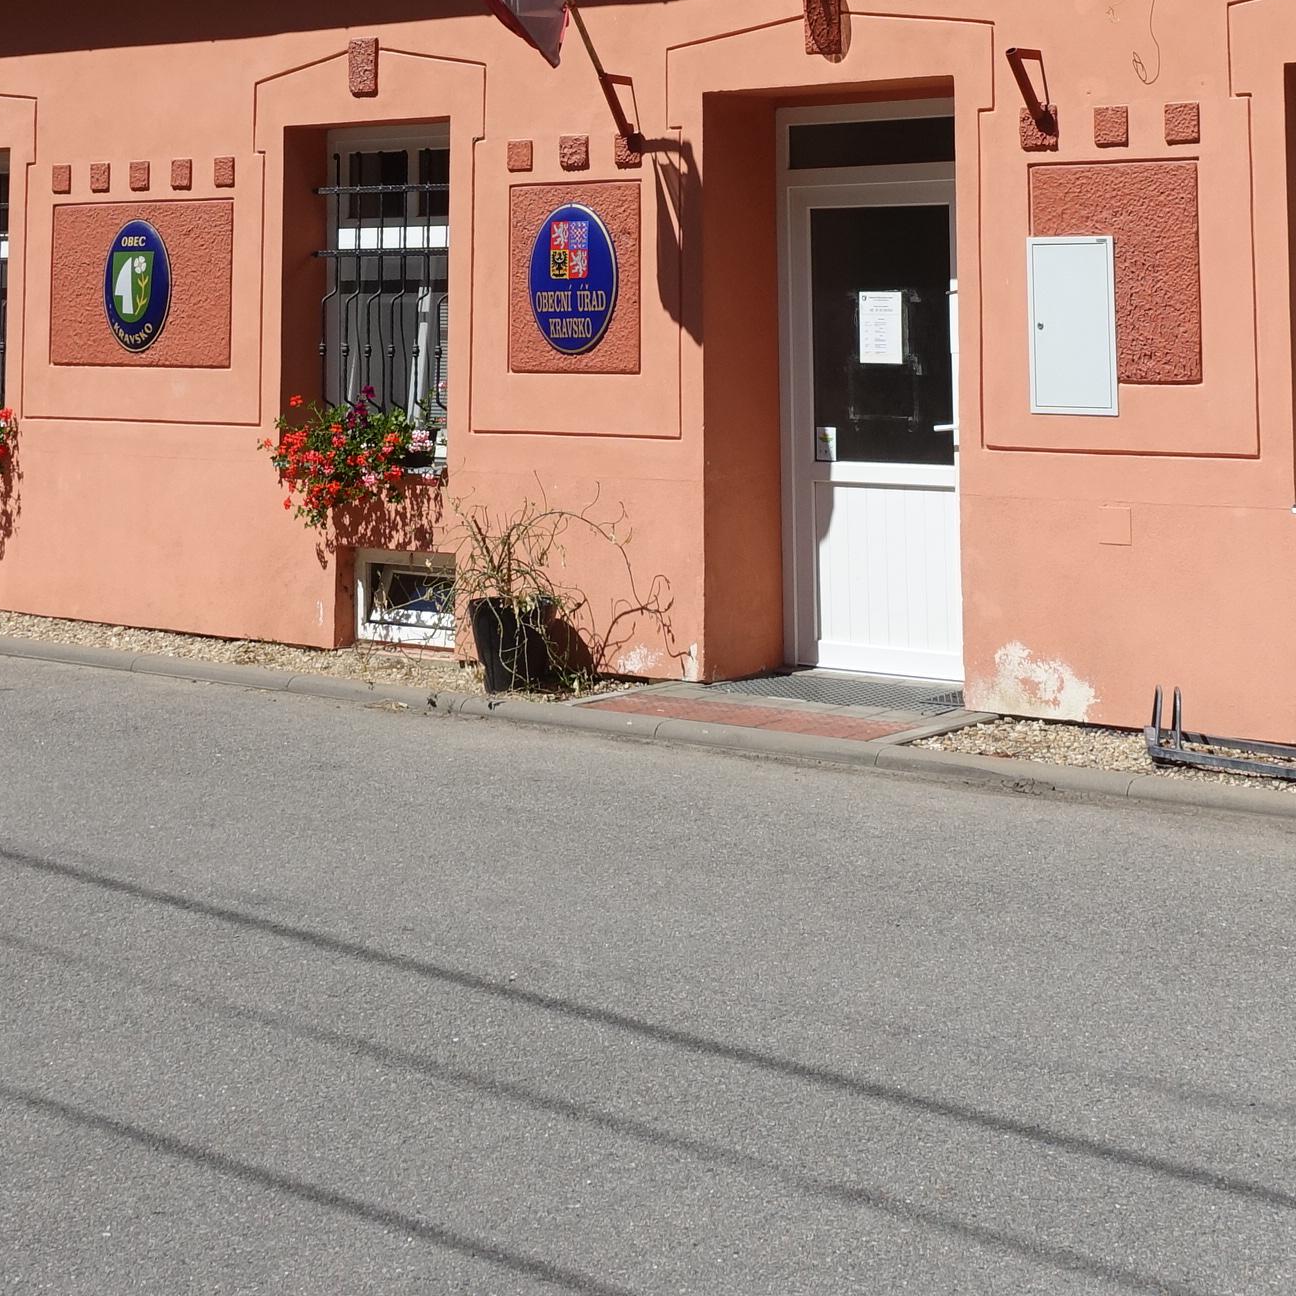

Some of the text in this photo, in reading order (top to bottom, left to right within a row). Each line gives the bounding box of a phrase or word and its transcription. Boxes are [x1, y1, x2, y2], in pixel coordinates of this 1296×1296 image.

[121, 236, 146, 247] OBEC
[535, 283, 606, 313] OBECNÍ ÚŘAD
[113, 322, 153, 345] KRAVSKO
[549, 317, 592, 338] KRAVSKO
